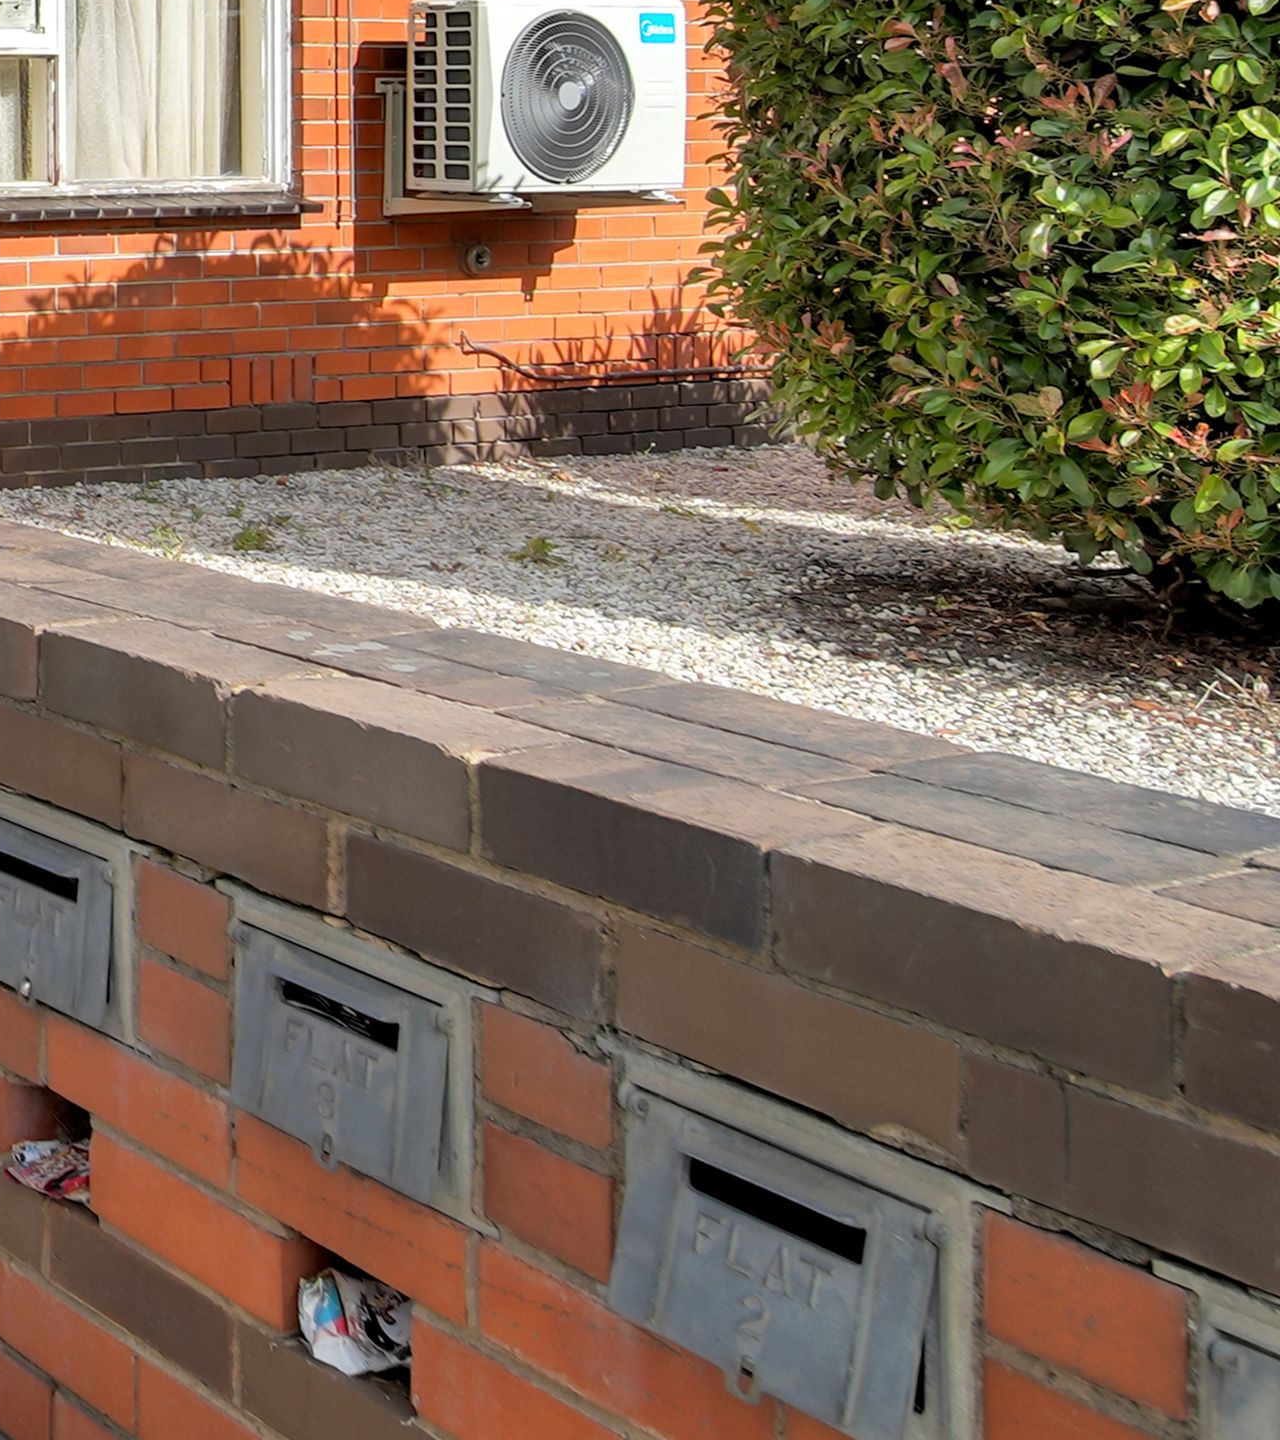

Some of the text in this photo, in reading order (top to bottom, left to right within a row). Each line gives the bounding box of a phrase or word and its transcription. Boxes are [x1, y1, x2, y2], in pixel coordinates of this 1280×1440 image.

[283, 1015, 381, 1089] FLAT
[691, 1209, 835, 1312] FLAT
[736, 1291, 771, 1344] 2
